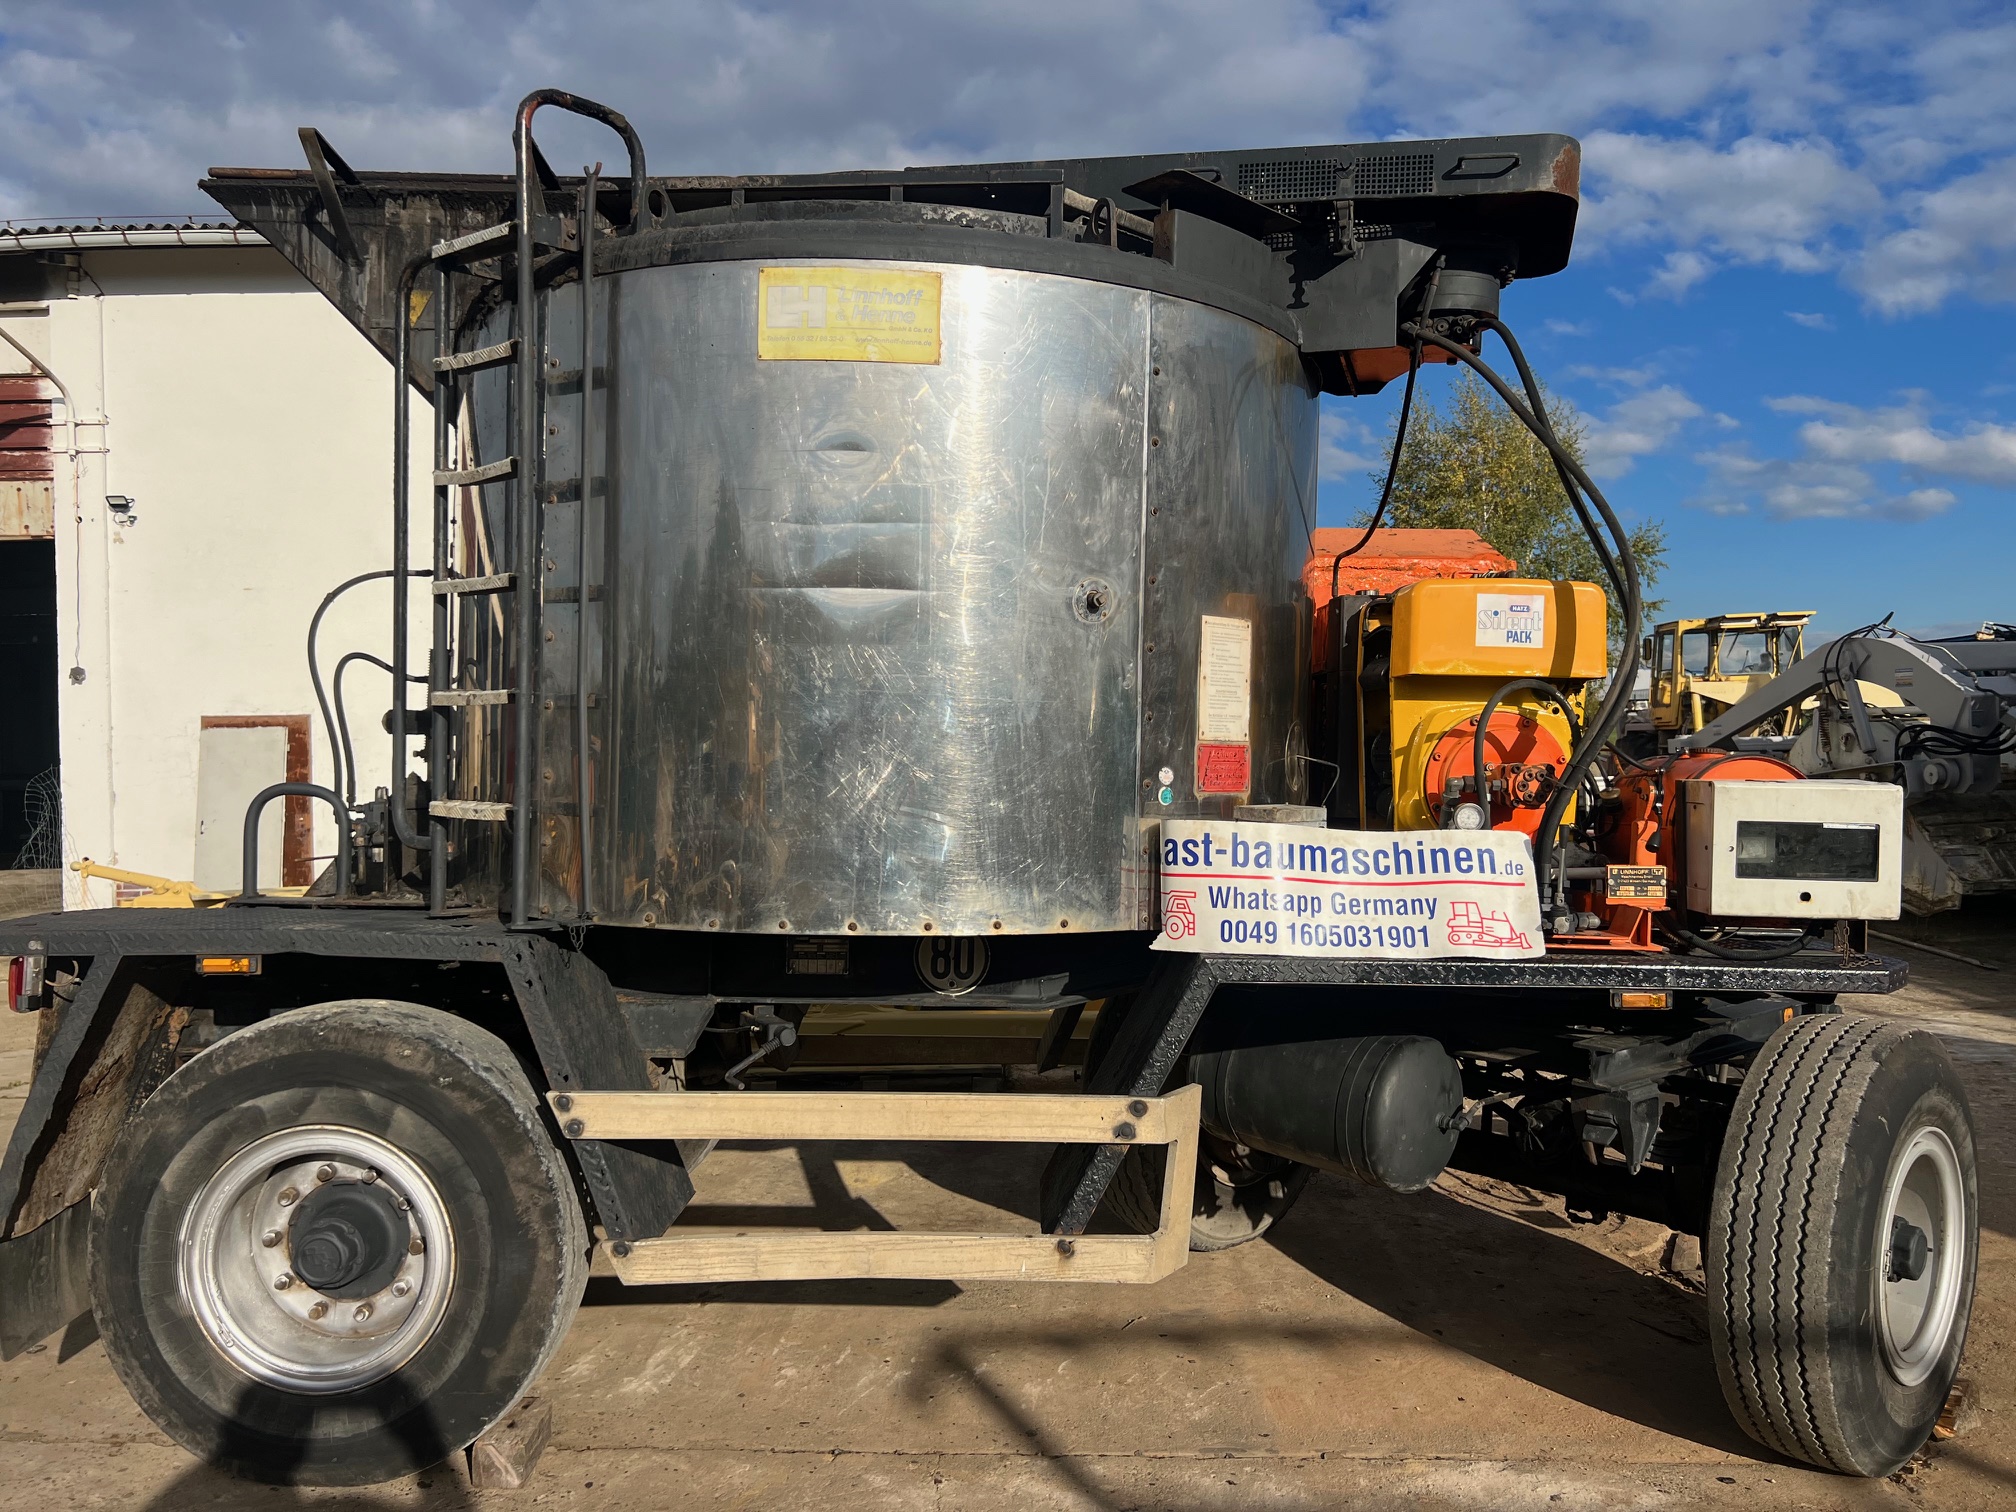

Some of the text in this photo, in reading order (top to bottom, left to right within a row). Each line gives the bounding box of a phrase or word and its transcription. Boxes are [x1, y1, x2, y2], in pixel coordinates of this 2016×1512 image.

[837, 286, 924, 306] Linnhoff
[835, 305, 916, 324] & Henne
[1478, 610, 1541, 631] Silent
[1506, 630, 1532, 643] PACK
[1207, 885, 1437, 920] Whatsapp Germany
[1220, 919, 1430, 948] 0049 1605031901
[930, 936, 975, 980] 80
